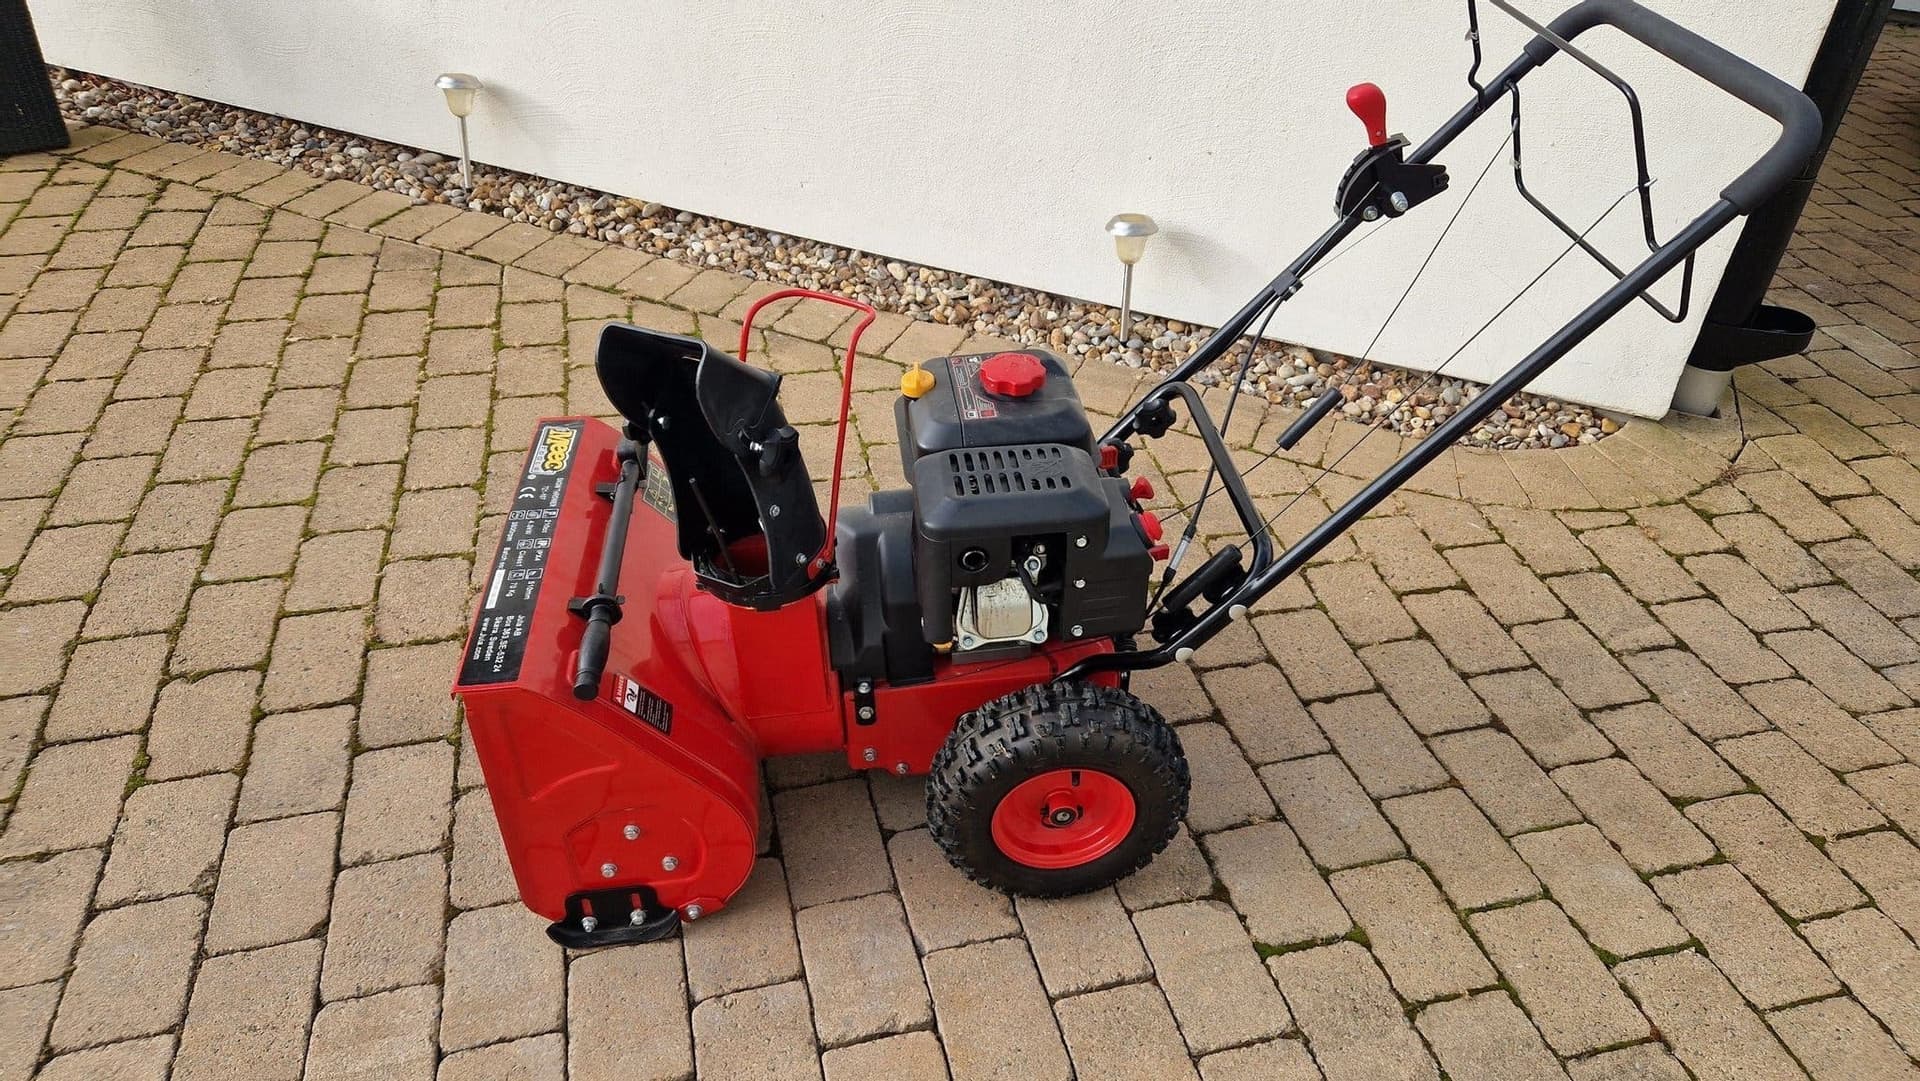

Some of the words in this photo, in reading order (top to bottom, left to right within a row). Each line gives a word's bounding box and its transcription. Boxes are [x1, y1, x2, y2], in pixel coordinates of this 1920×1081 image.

[543, 429, 572, 471] Meec
[534, 549, 543, 561] IPX4
[524, 581, 535, 600] 510mm
[490, 616, 503, 635] Skara,
[504, 616, 514, 627] Box
[516, 614, 525, 627] Jula
[473, 617, 490, 660] www.Jula.com
[513, 627, 522, 636] AB
[484, 637, 497, 661] Sweden
